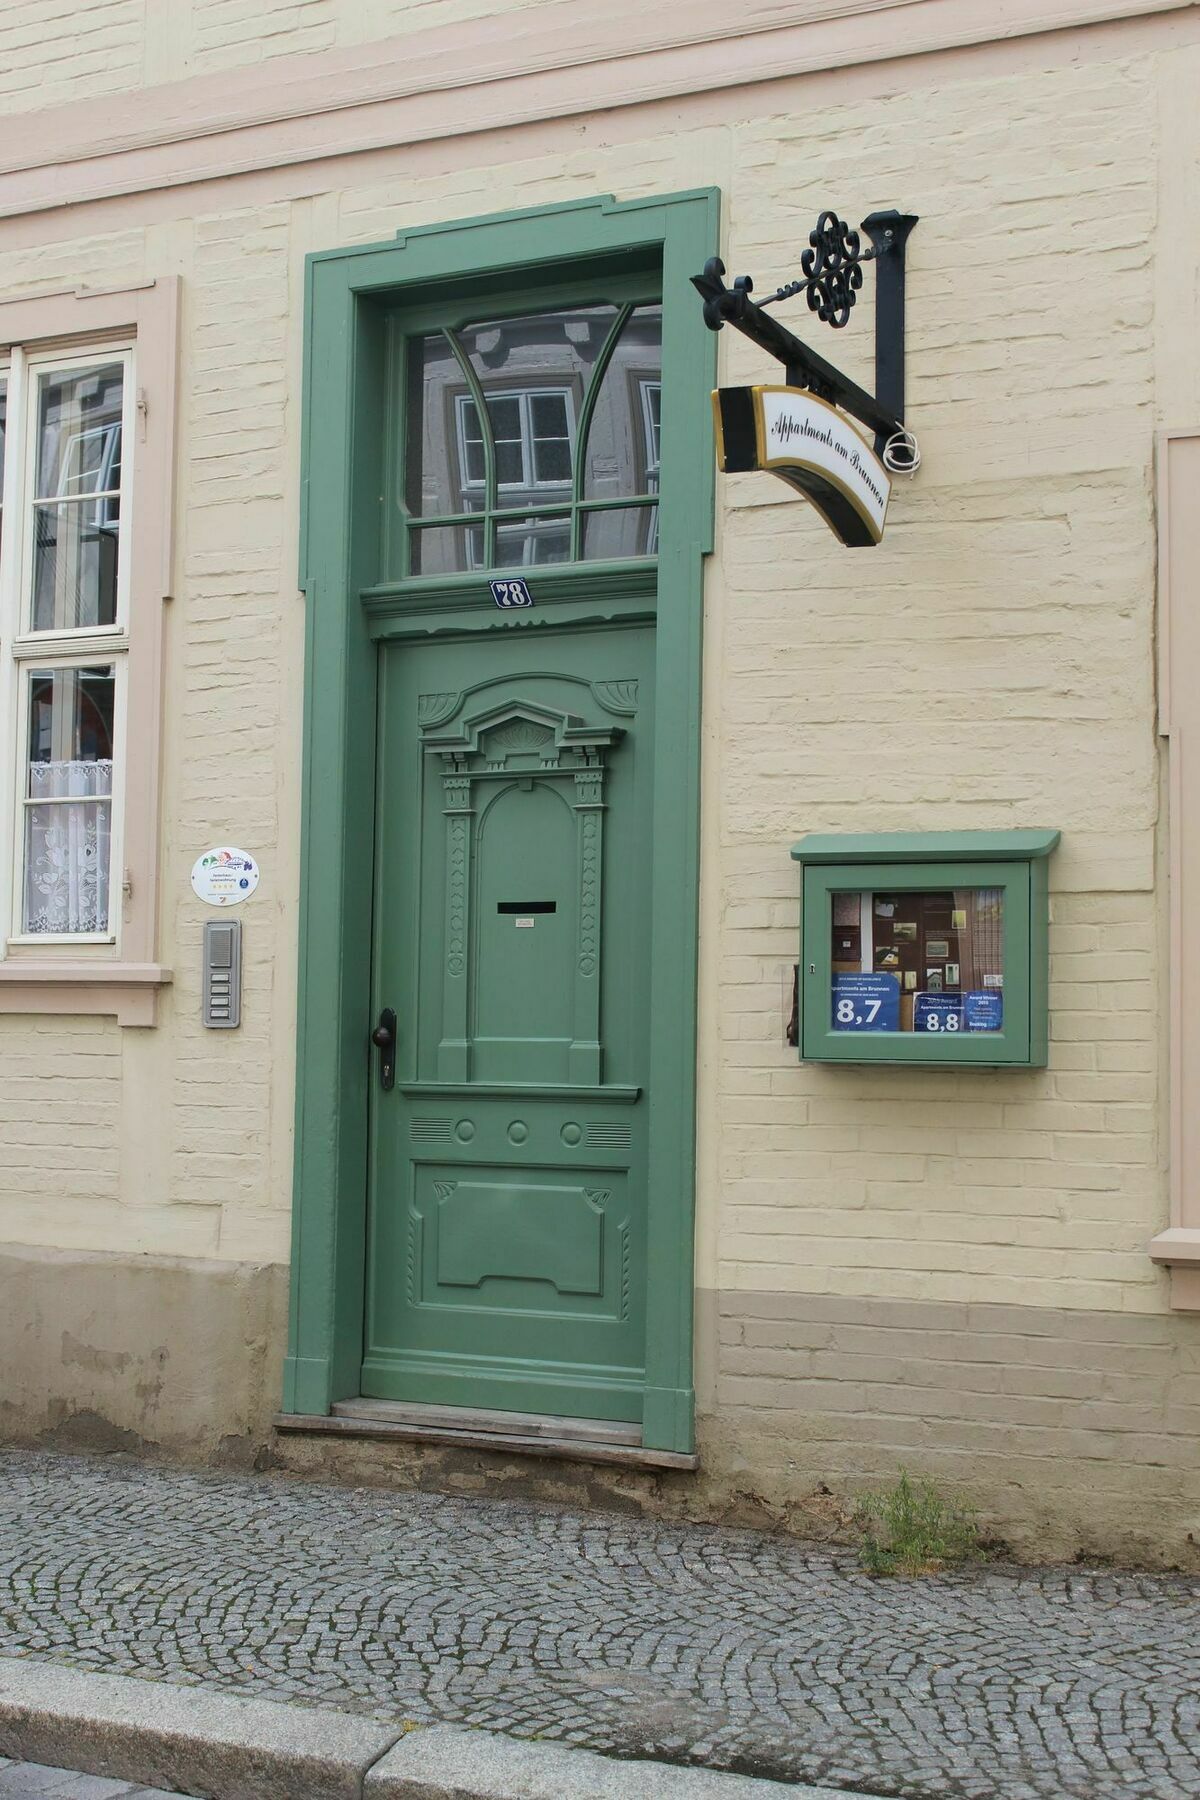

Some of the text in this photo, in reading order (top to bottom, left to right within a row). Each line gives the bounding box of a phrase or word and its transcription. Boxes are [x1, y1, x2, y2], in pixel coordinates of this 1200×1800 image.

[771, 412, 884, 507] Appartments am Brunnen
[495, 582, 525, 606] 78
[836, 999, 882, 1025] 8,7
[926, 1013, 959, 1032] 8,8
